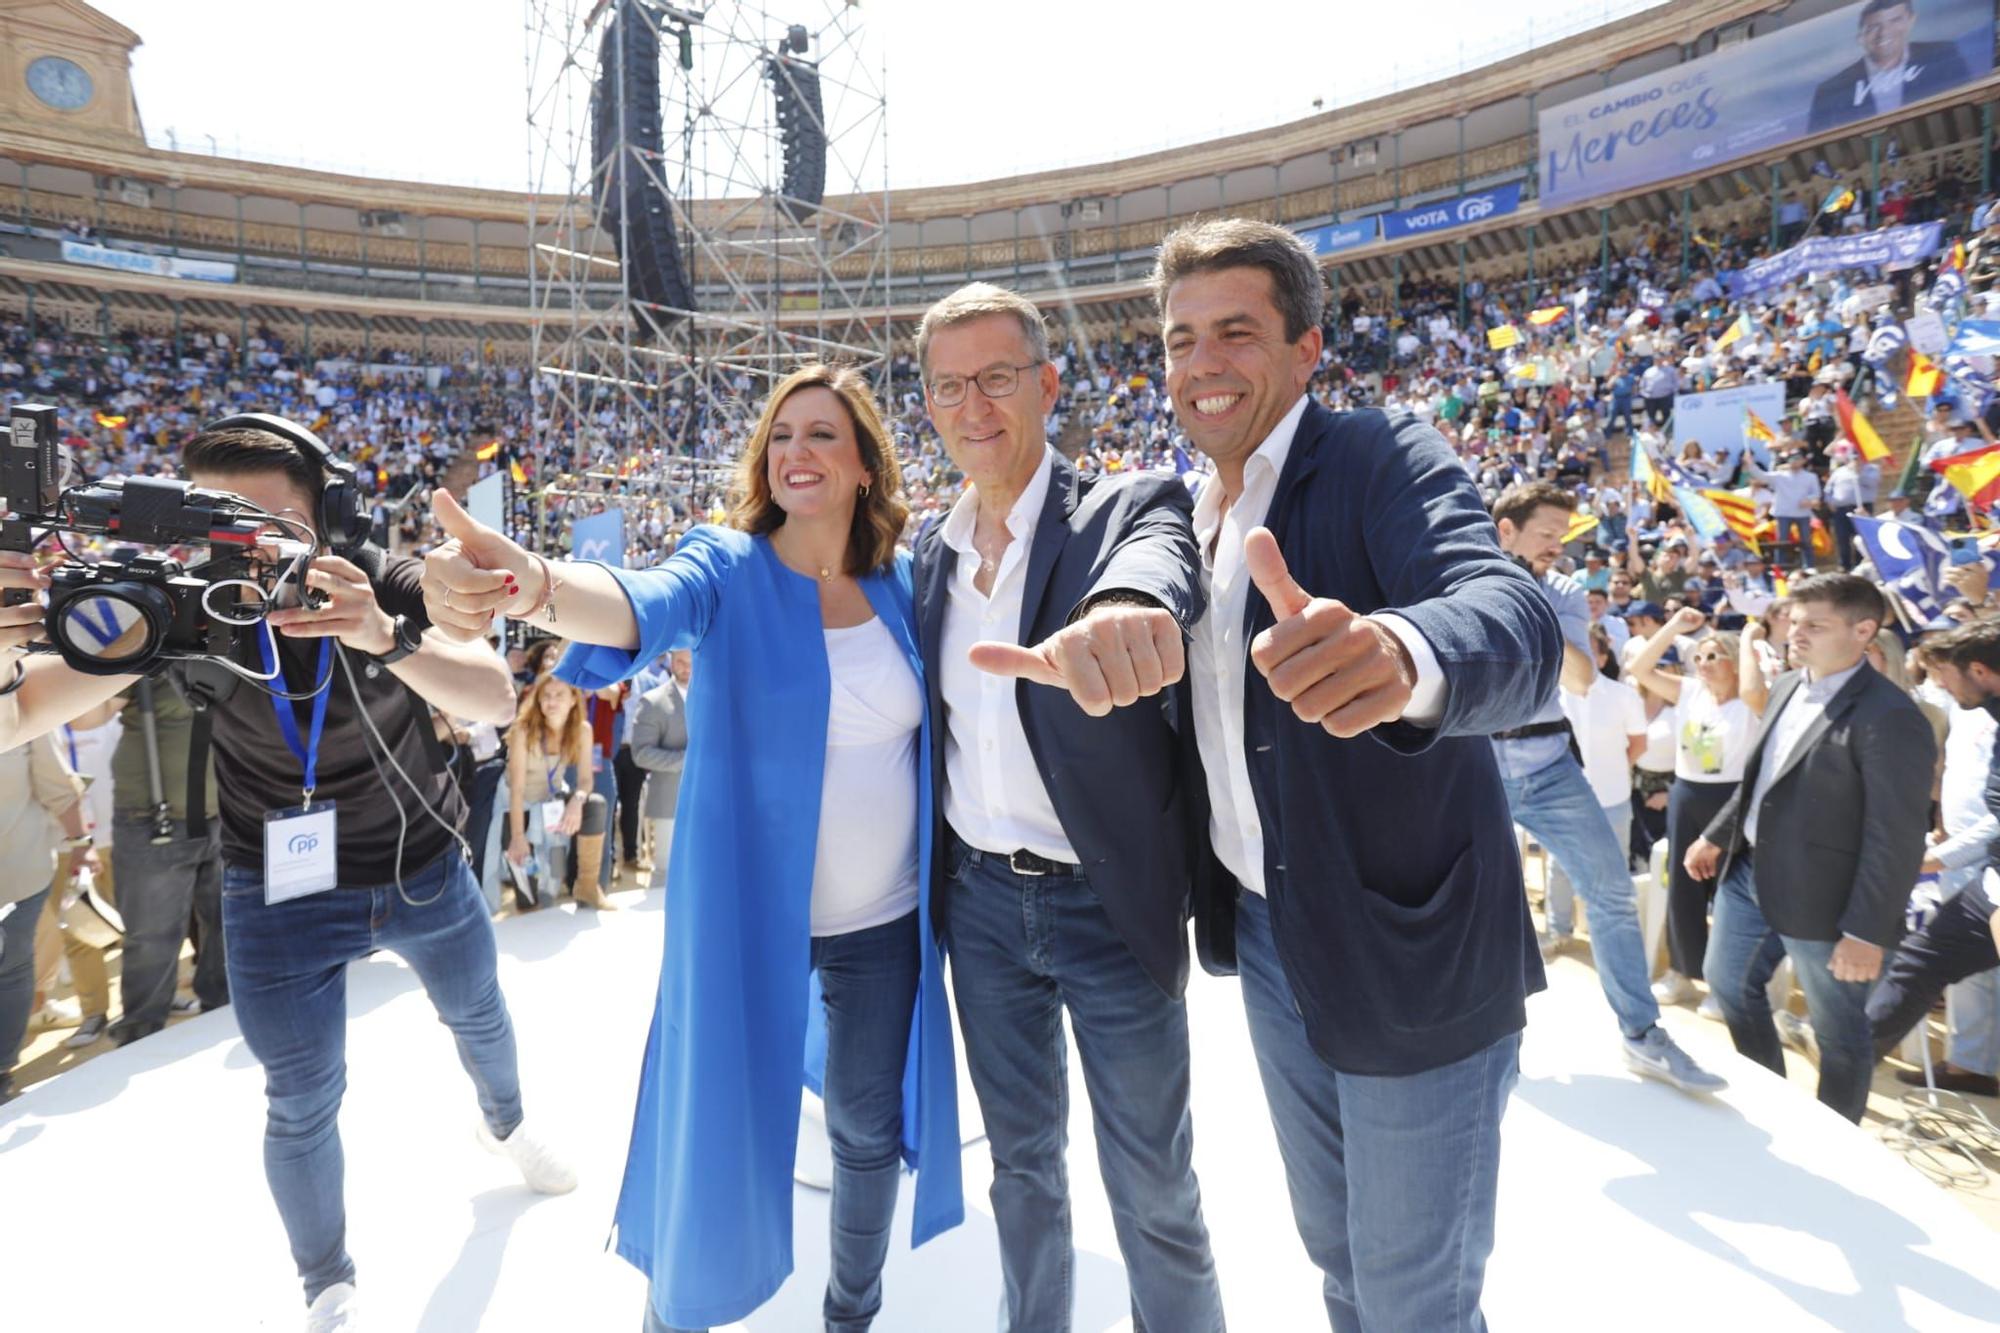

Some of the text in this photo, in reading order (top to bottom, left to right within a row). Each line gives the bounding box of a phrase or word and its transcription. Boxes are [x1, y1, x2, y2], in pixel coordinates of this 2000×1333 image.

[1563, 70, 1709, 128] EL CAMBIO QUE
[1547, 87, 1724, 193] Mereces
[1405, 209, 1449, 230] VOTA
[127, 566, 158, 576] SONY
